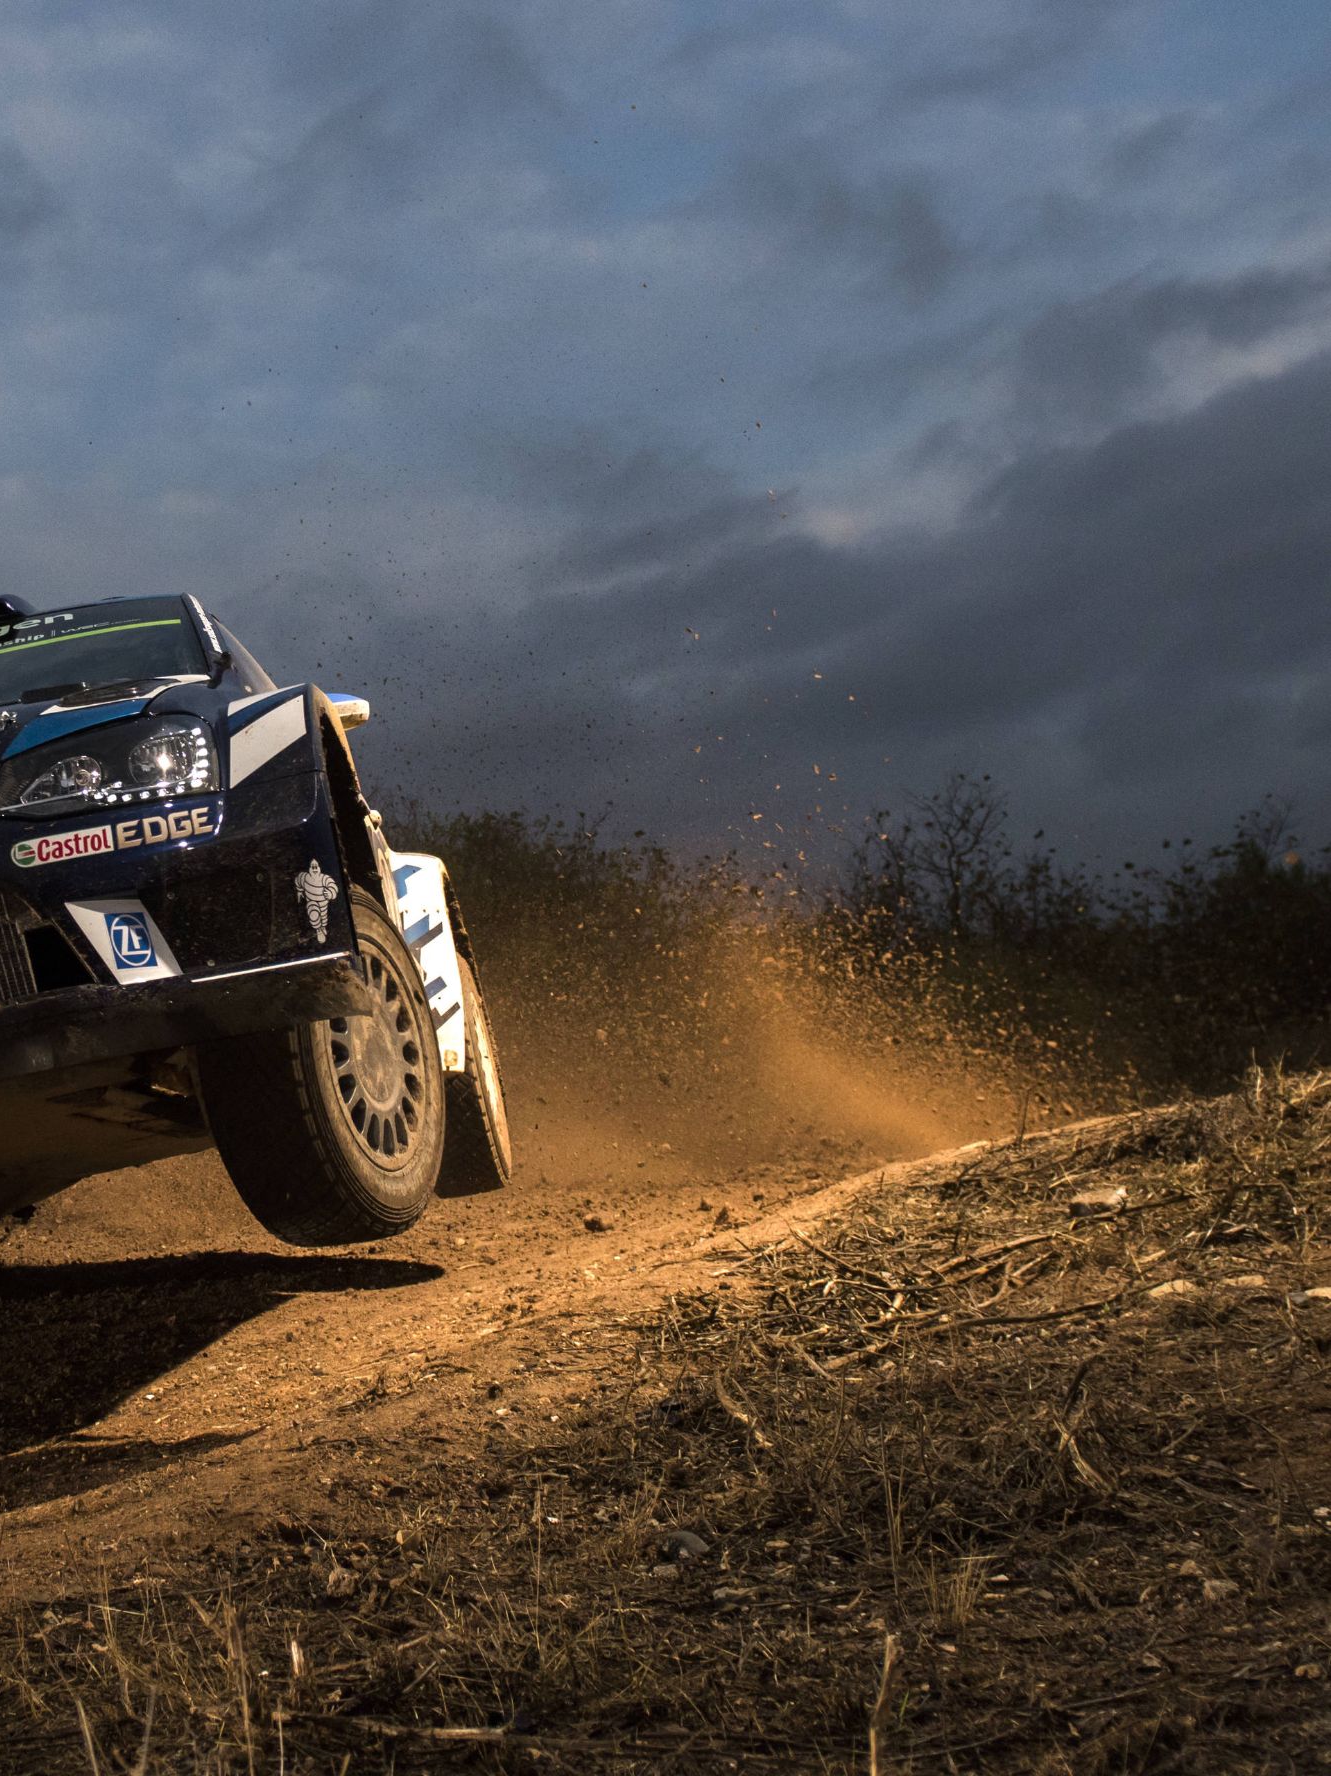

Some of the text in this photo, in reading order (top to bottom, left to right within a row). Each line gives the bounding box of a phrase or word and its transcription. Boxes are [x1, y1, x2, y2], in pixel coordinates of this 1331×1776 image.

[37, 806, 213, 862] Castrol EDGE
[112, 925, 151, 956] ZF
